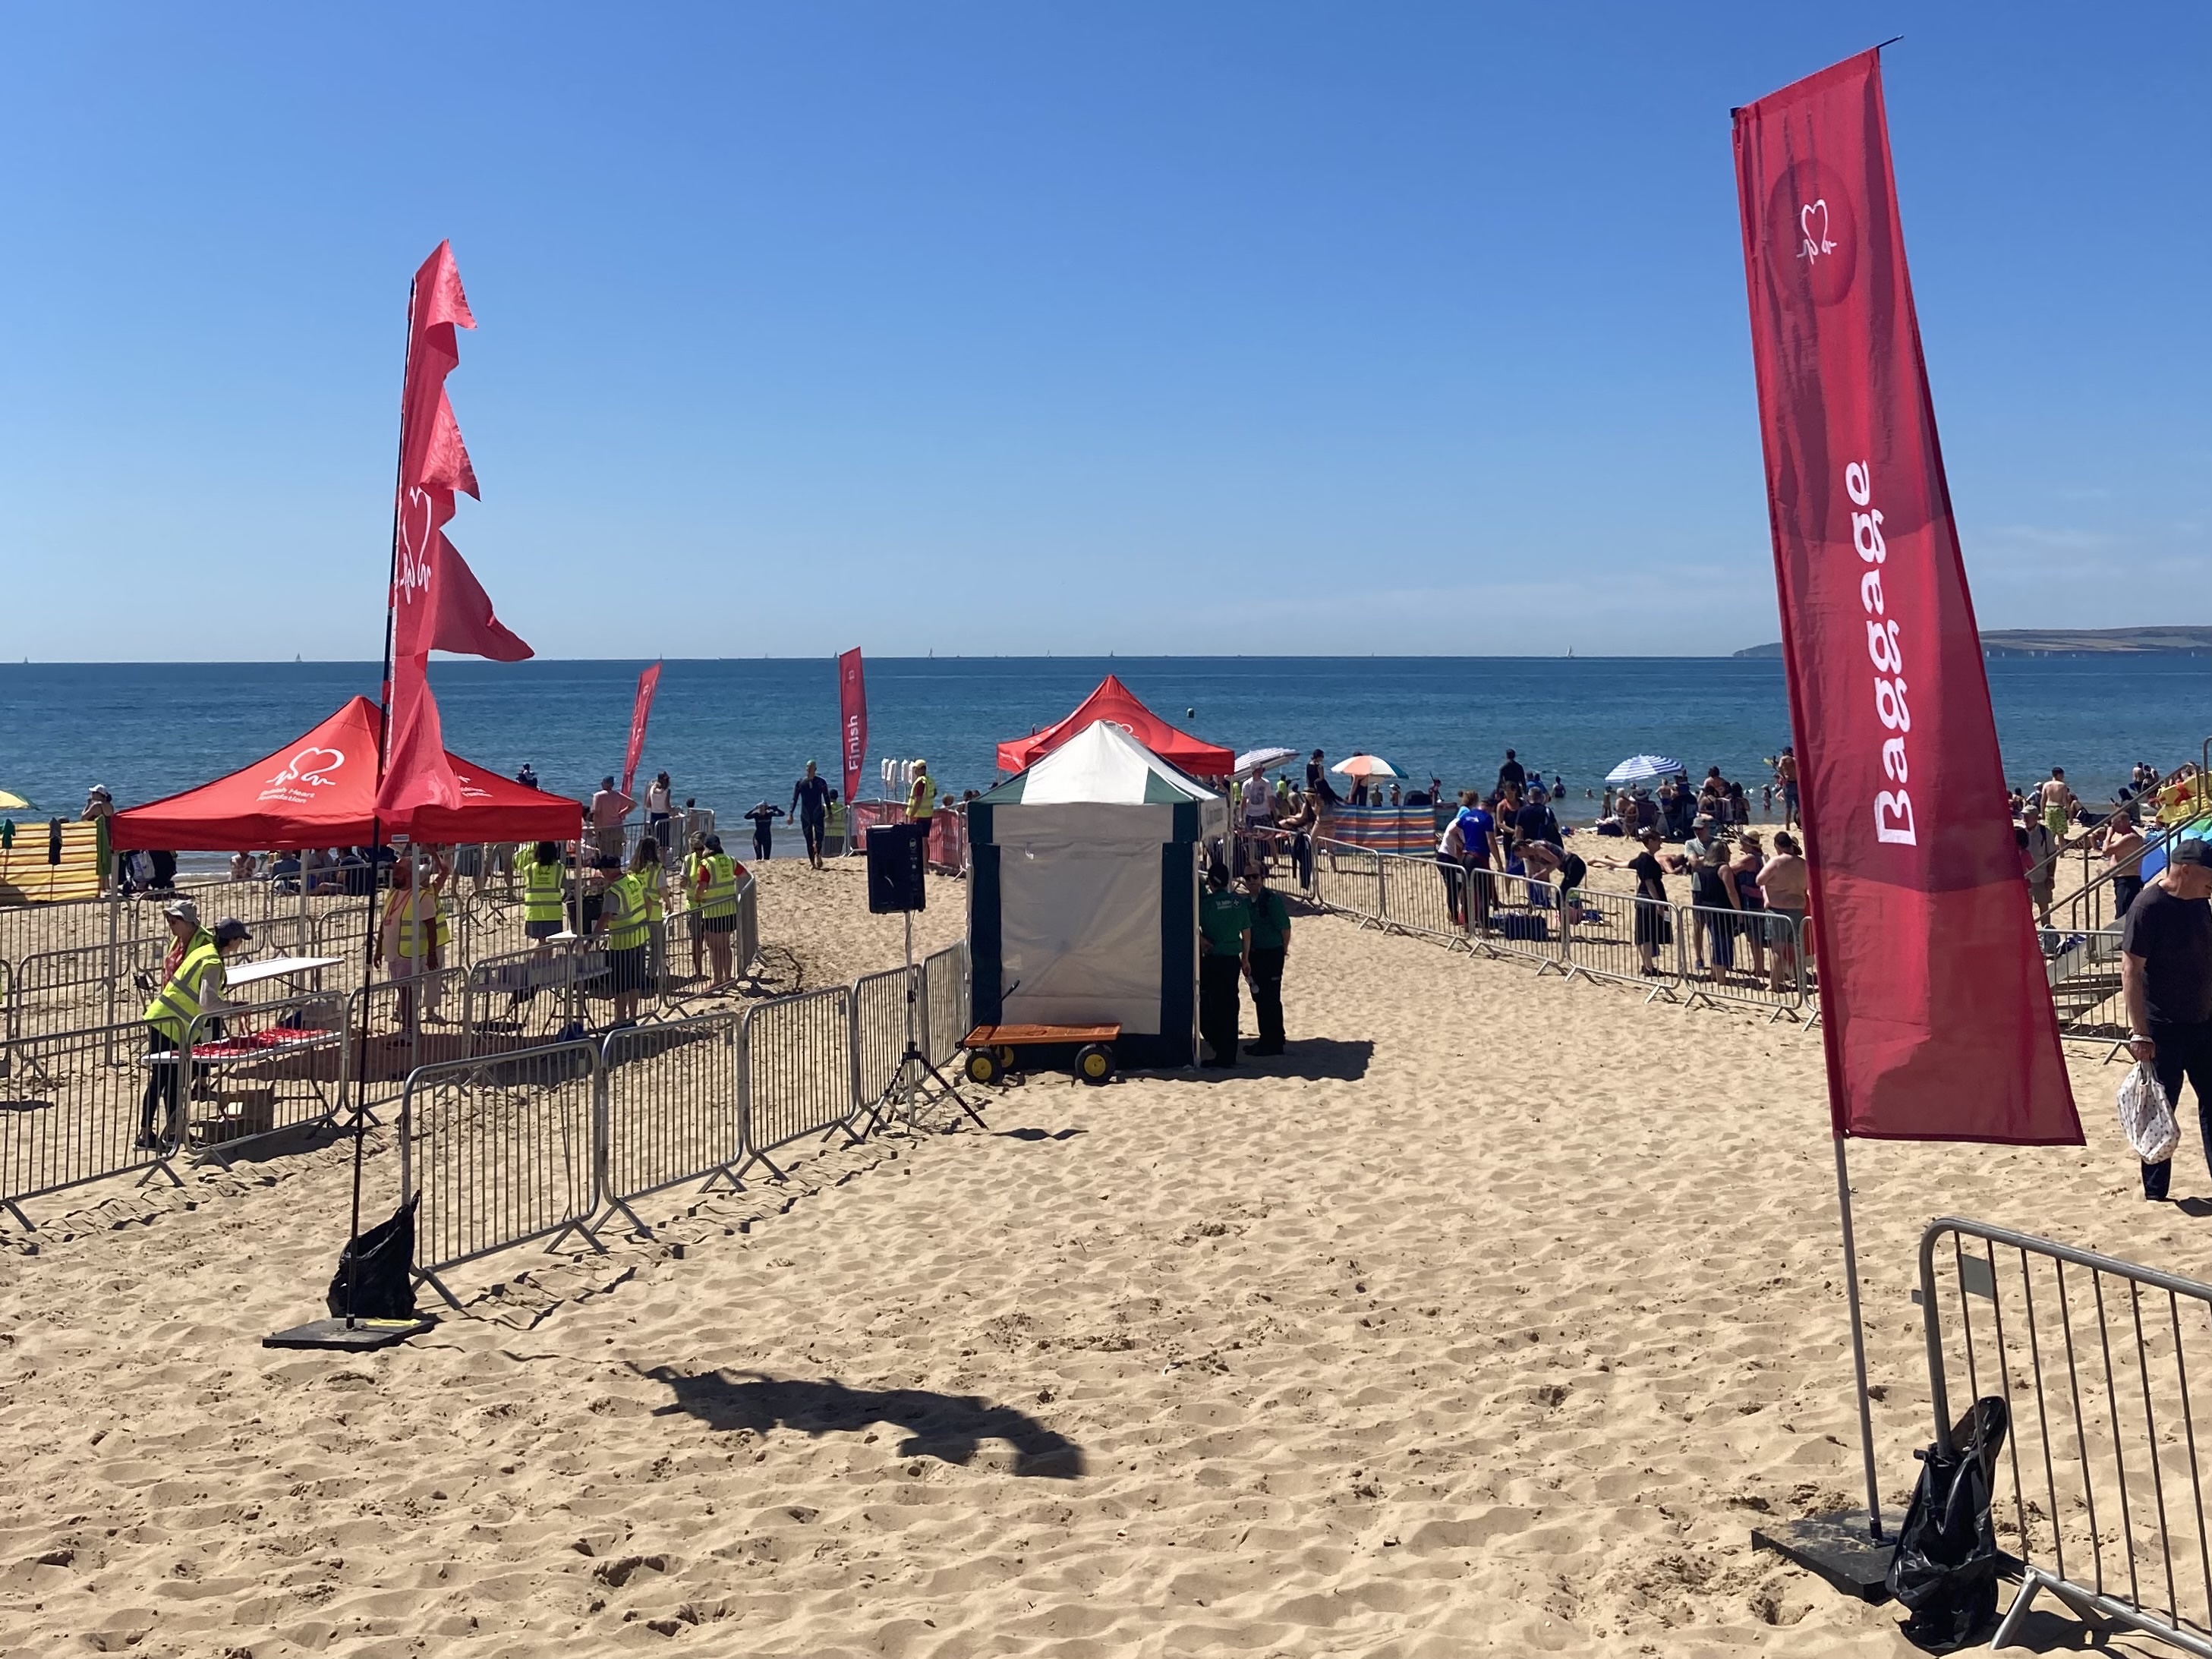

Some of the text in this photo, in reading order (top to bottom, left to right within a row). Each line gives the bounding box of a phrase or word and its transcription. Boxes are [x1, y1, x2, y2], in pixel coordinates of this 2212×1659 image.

[1845, 459, 1917, 846] Baggage
[847, 714, 859, 771] Finish
[288, 789, 315, 798] Heart
